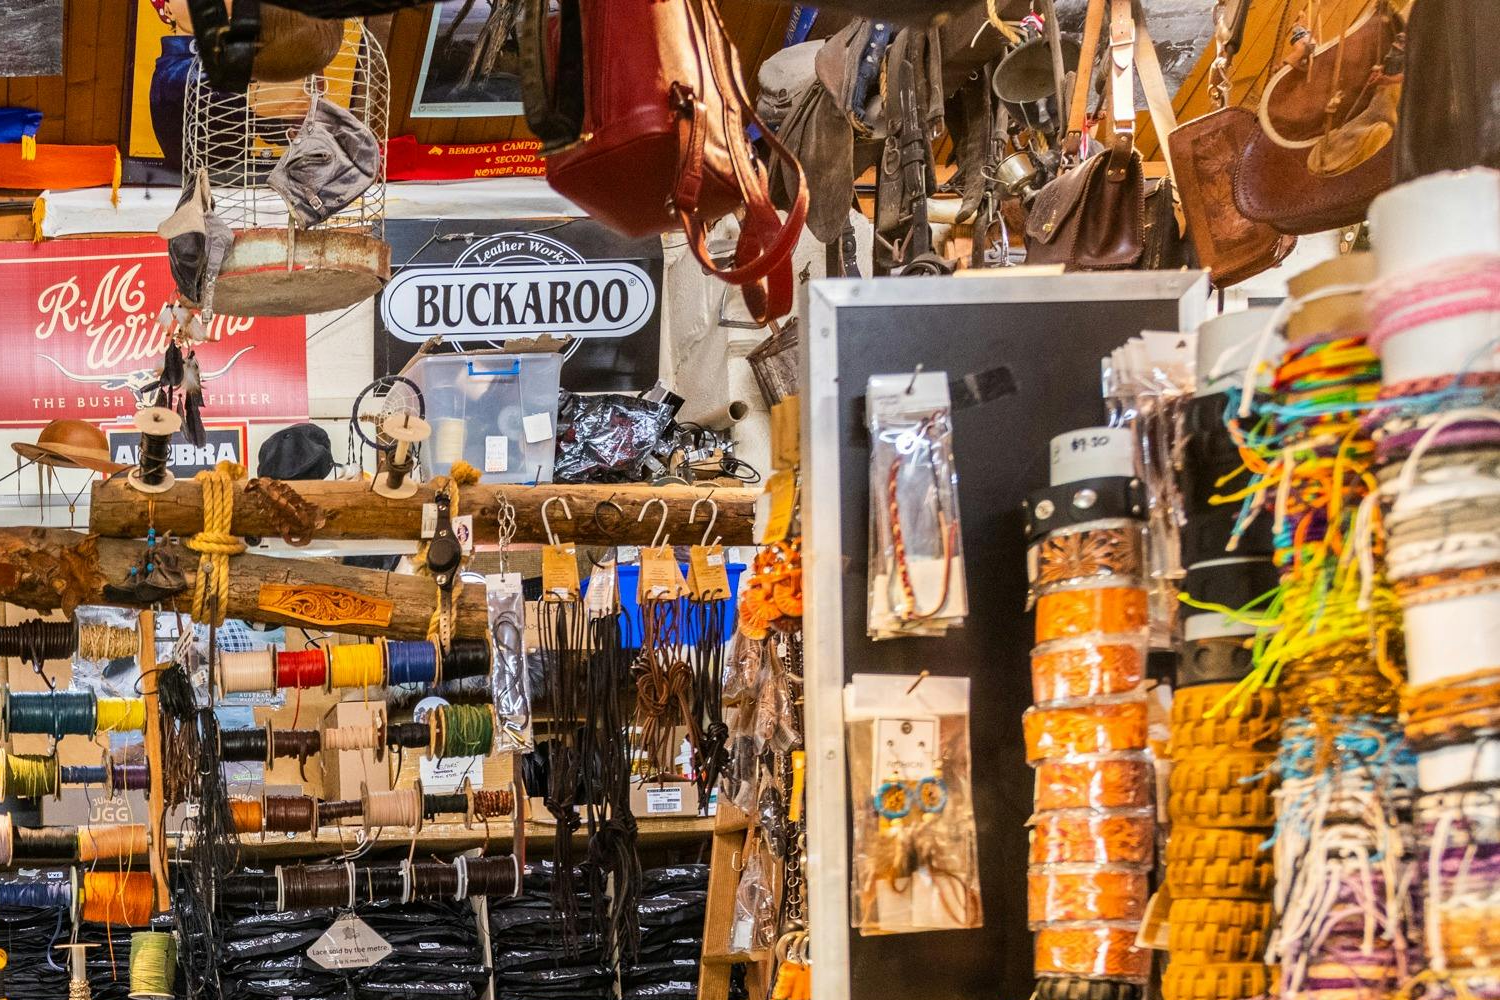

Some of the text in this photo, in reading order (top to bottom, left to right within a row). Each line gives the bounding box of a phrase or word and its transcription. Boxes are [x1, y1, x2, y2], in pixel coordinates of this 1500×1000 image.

[448, 145, 496, 155] BEMBOKA
[495, 155, 535, 164] SECOND
[473, 240, 570, 265] Leather Works
[415, 279, 628, 328] BUCKAROO
[32, 393, 271, 409] THE BUSH OFITTER
[92, 796, 123, 806] JUMBO
[89, 807, 128, 822] UGG
